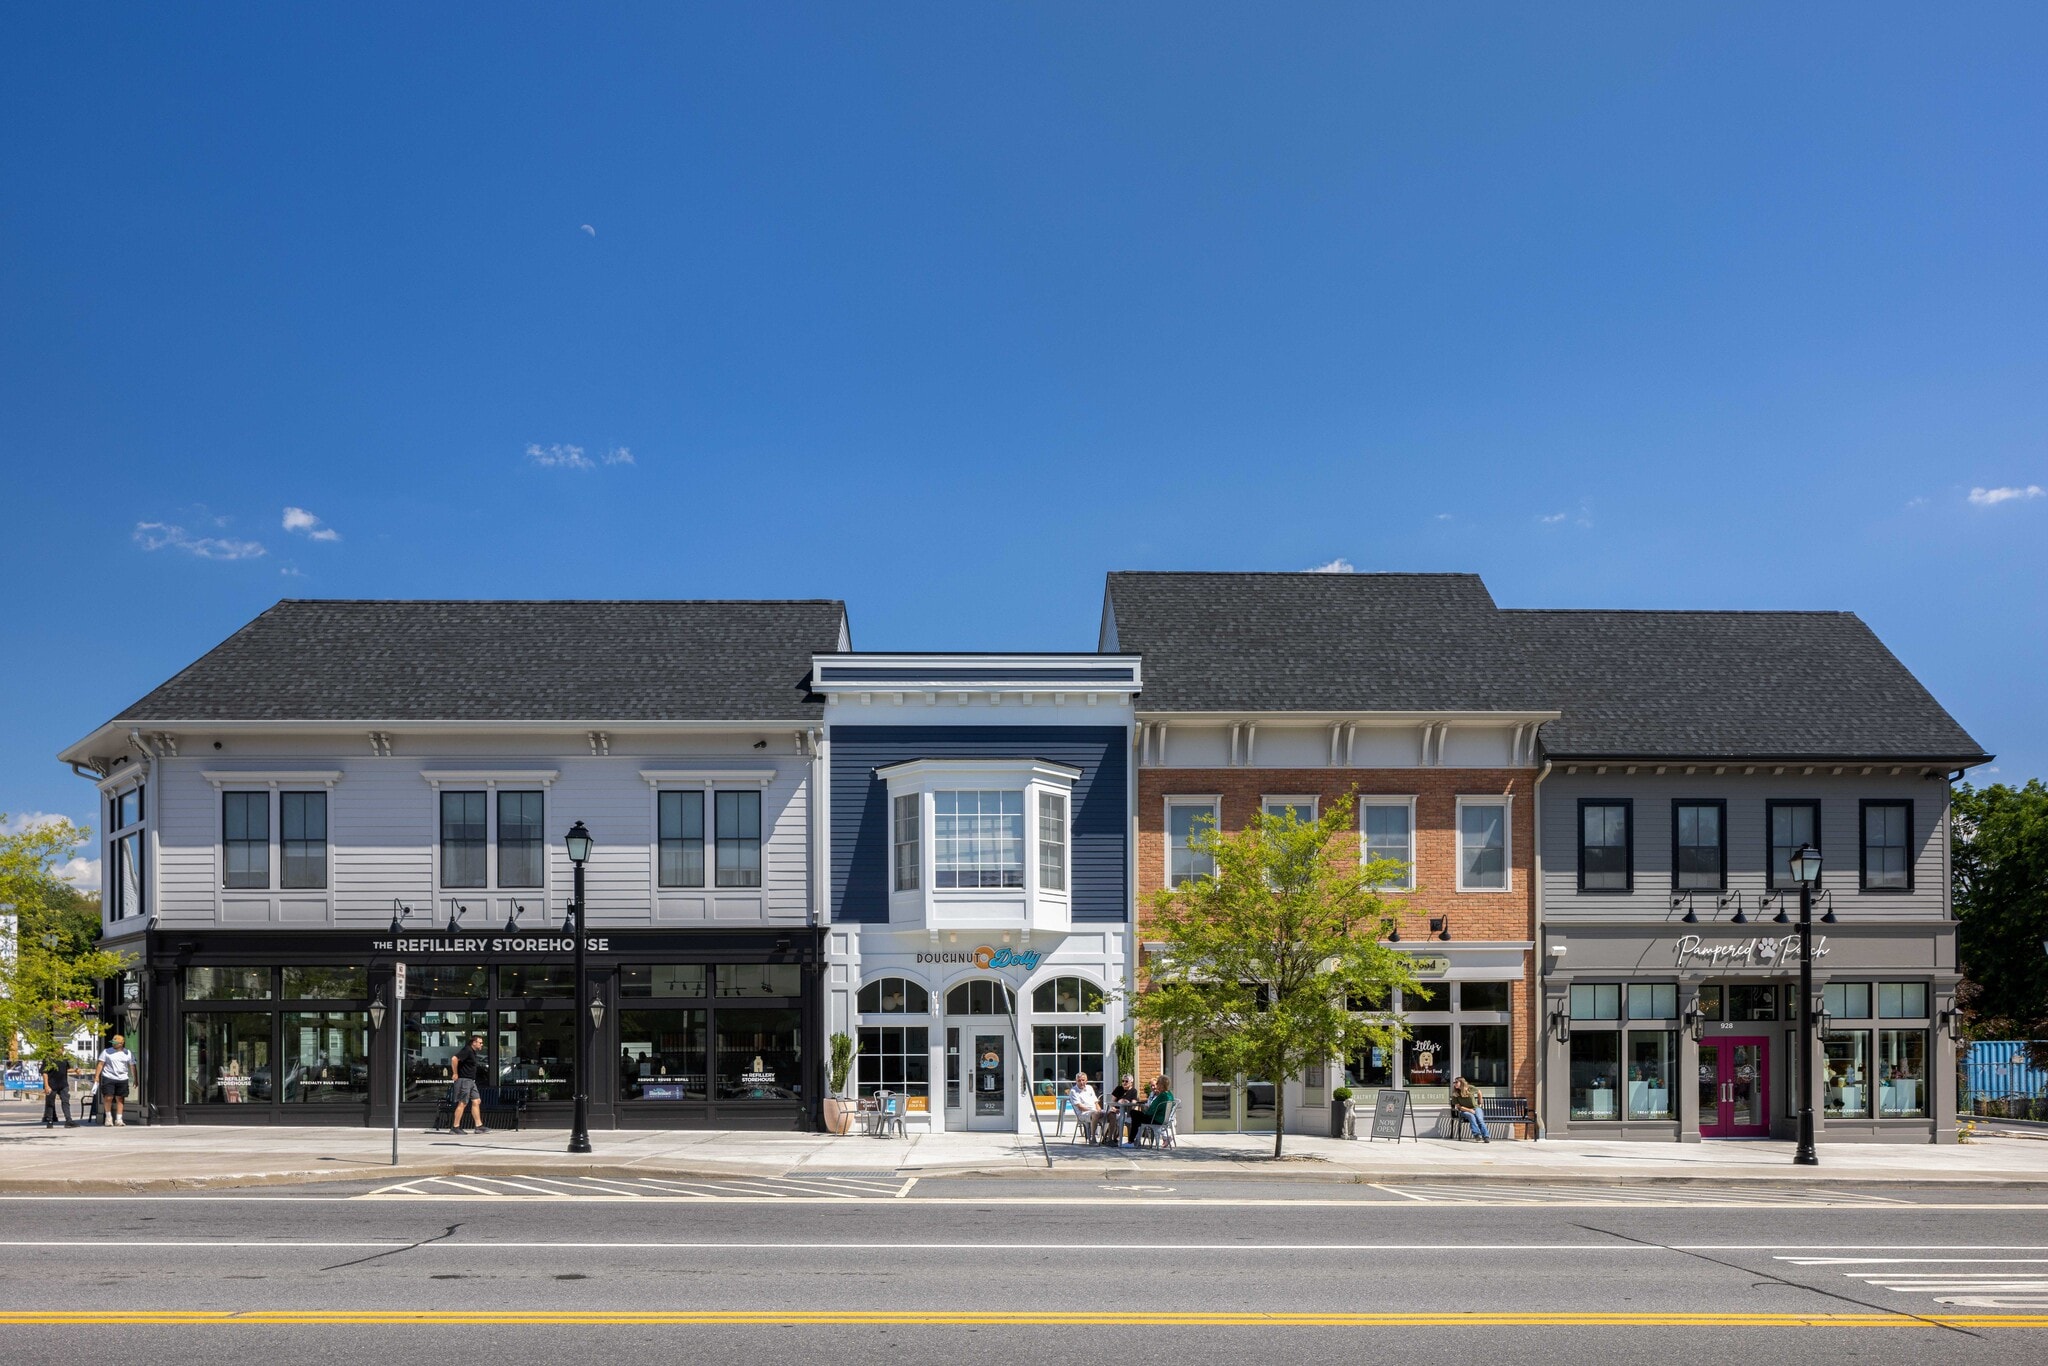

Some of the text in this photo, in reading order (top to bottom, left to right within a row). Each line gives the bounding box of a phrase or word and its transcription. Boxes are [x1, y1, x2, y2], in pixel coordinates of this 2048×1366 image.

[373, 938, 609, 952] THE REFILLERY STOREHOSE
[1676, 935, 1830, 964] Pampered Poch
[916, 947, 1042, 970] DOUGHNUT Dolly
[1058, 1032, 1077, 1041] Open
[1412, 1040, 1441, 1053] Lilly's
